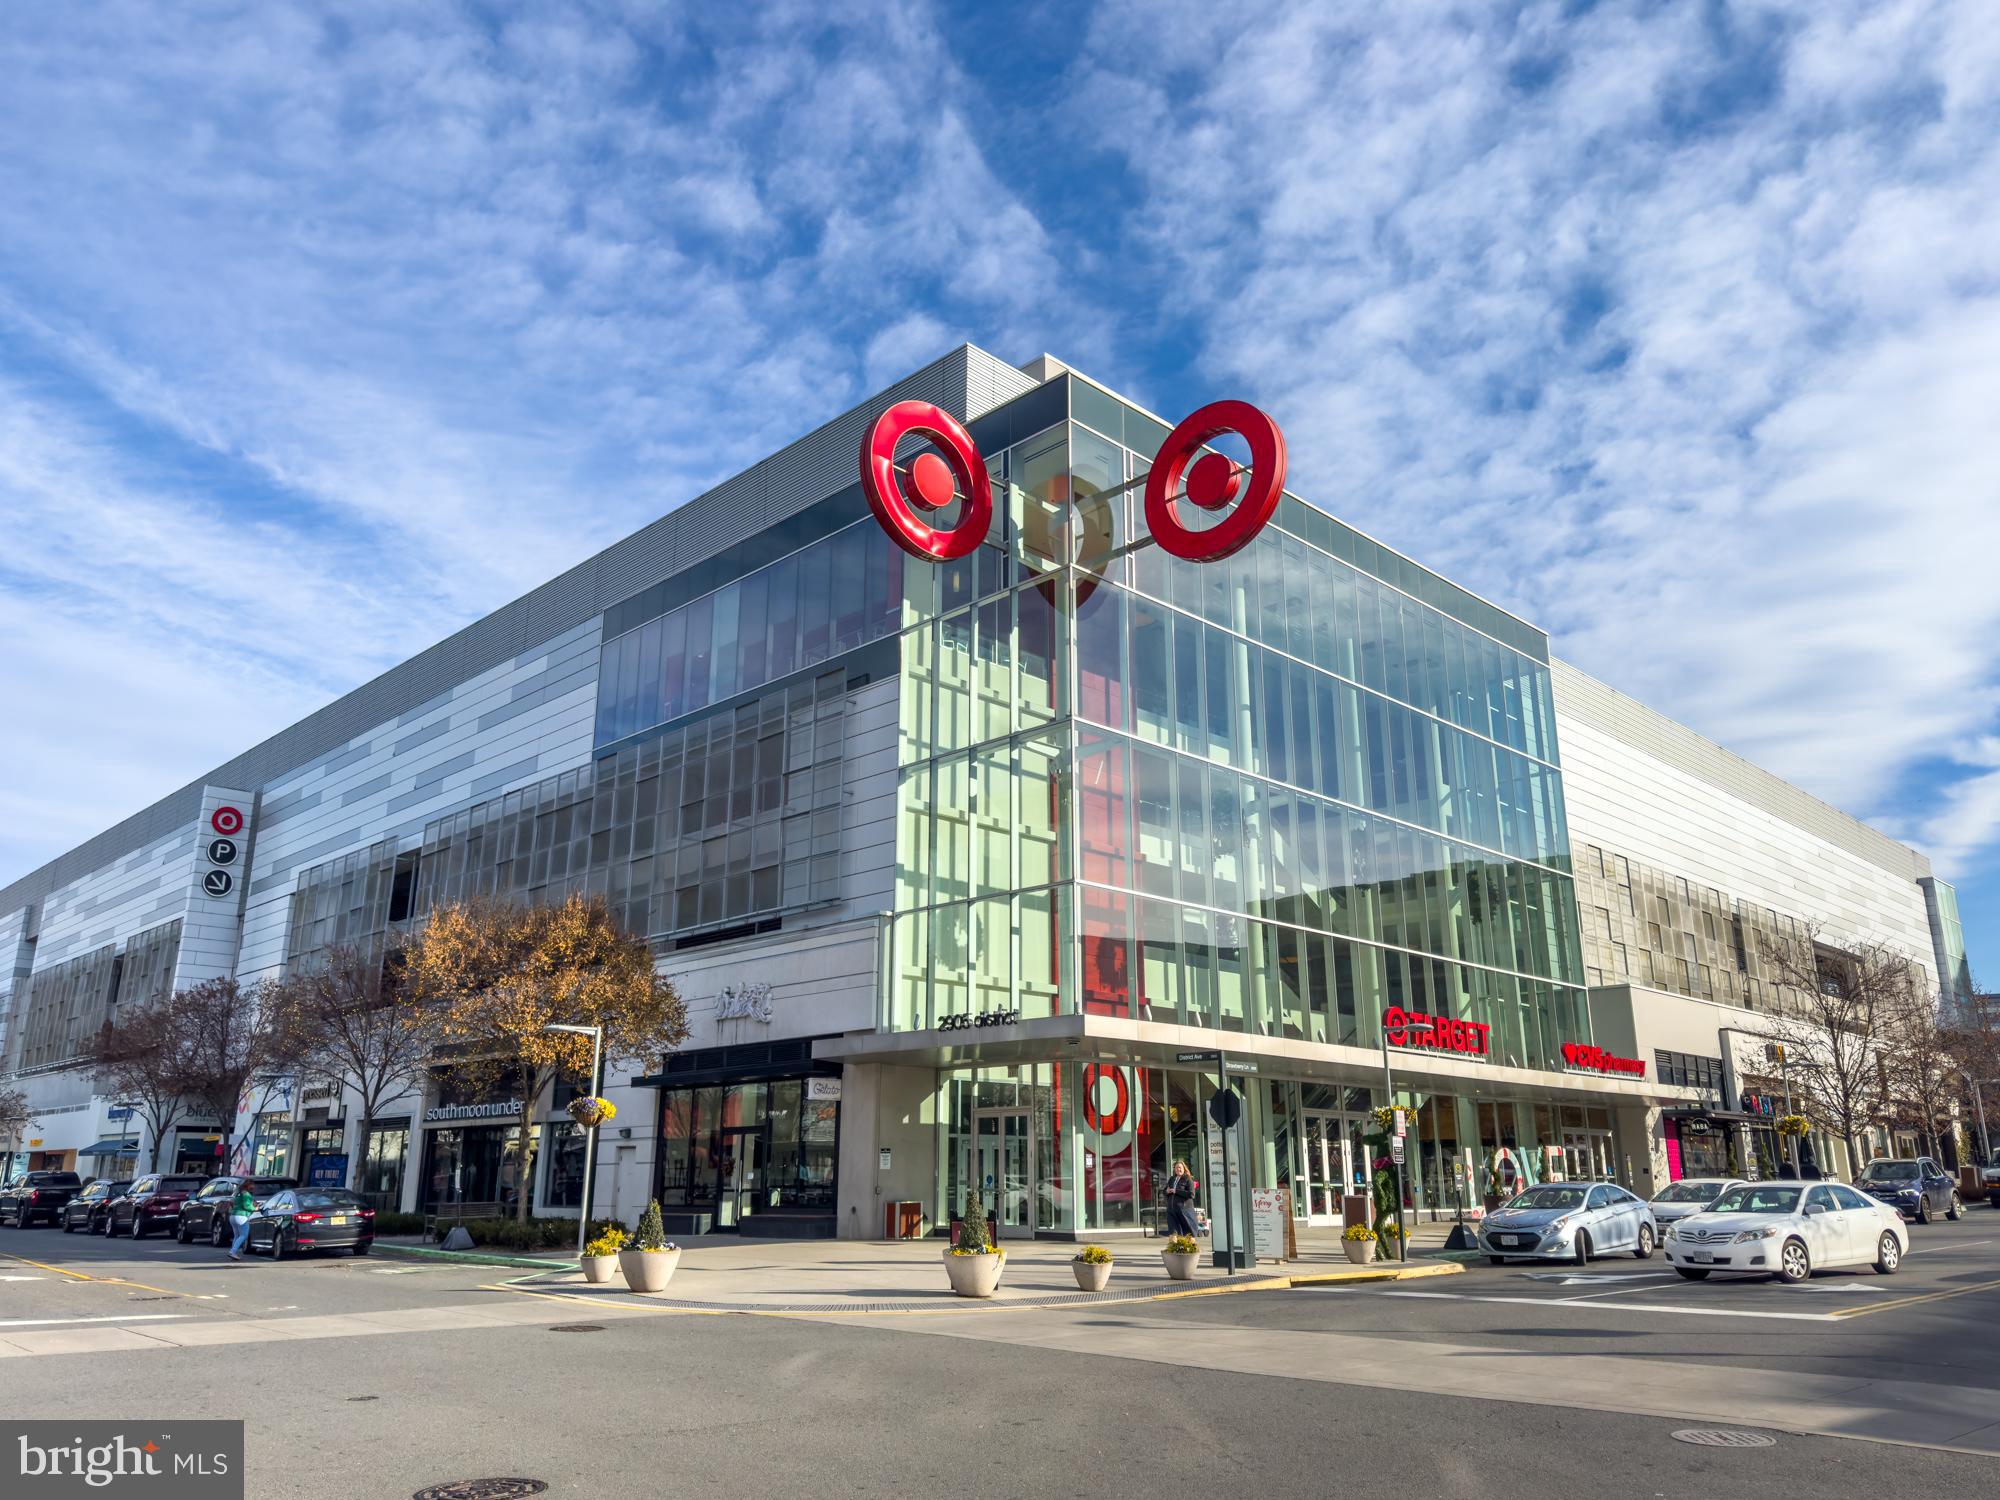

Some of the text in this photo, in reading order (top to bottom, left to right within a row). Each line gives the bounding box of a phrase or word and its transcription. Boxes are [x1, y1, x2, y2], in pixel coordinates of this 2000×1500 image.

[216, 843, 231, 859] P
[937, 1003, 1019, 1032] 2905 district
[1408, 1011, 1490, 1055] TARGET
[1577, 1043, 1646, 1078] CVS pharmacy
[813, 1082, 841, 1096] Gelato
[426, 1098, 526, 1120] south moon under
